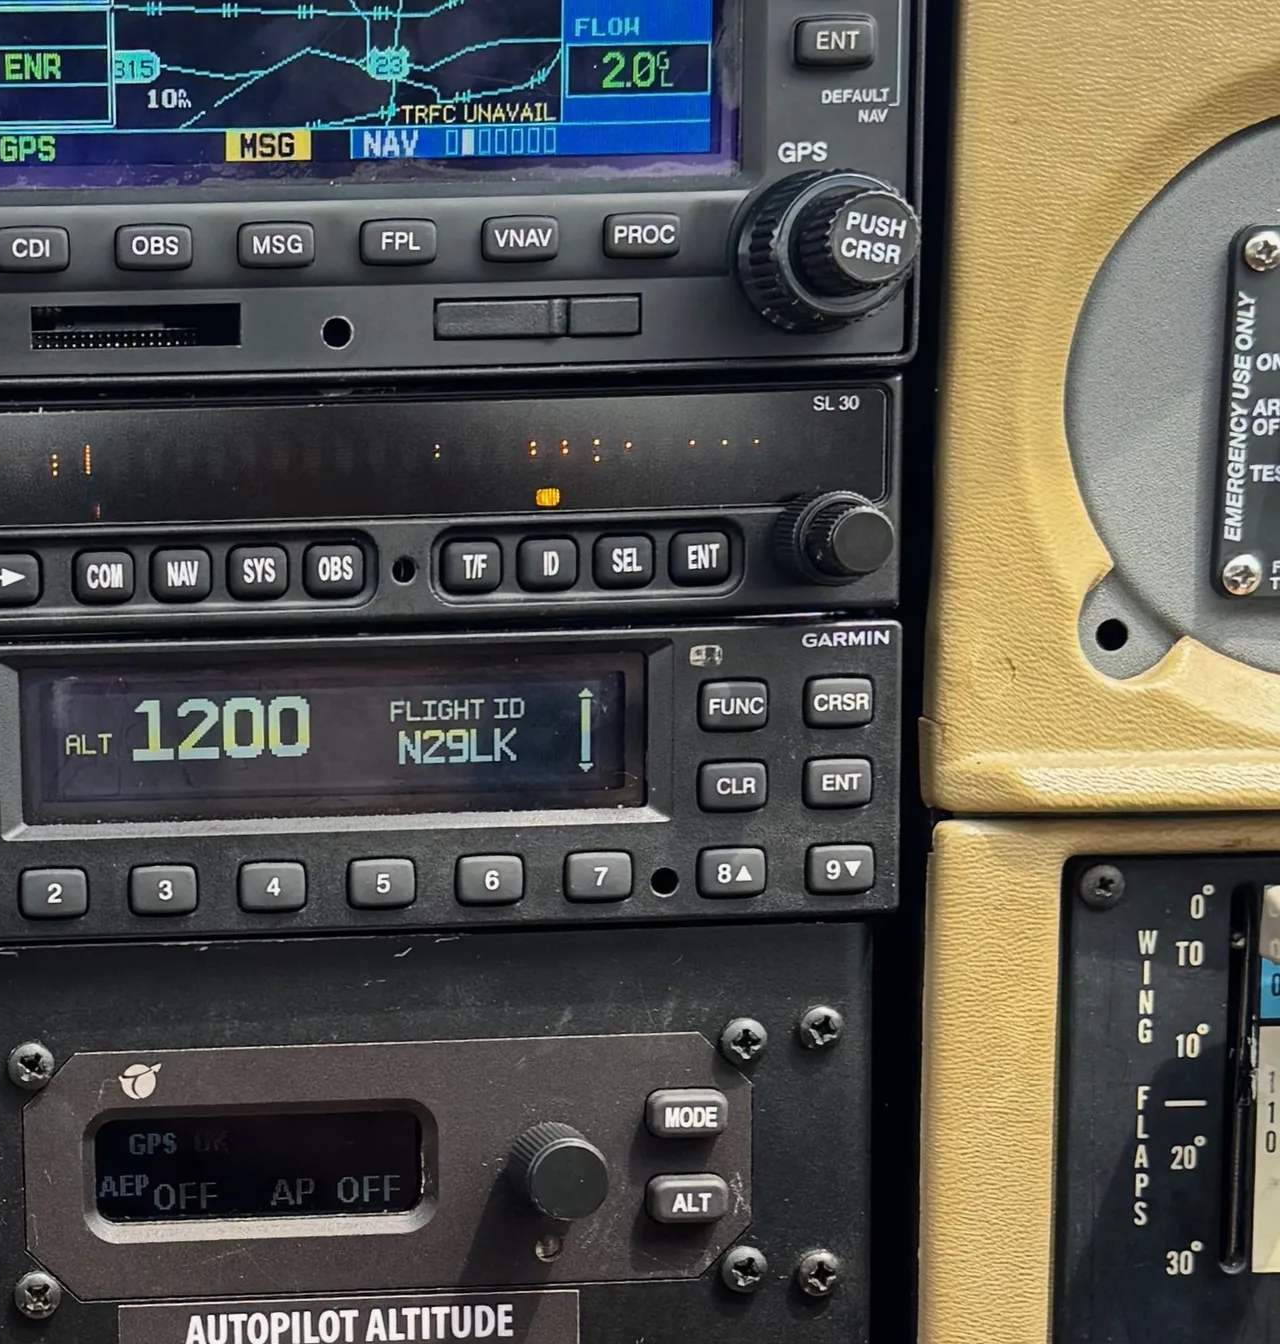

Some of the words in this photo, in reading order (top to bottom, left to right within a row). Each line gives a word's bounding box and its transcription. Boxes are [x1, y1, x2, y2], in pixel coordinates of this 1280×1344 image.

[574, 17, 639, 36] FLOW
[816, 32, 858, 50] ENT
[5, 54, 62, 80] ENR
[822, 88, 889, 104] DEFAULT
[401, 105, 457, 122] TRFC
[464, 103, 556, 122] UNAVAIL
[858, 108, 888, 123] NAV
[0, 136, 56, 162] GPS
[239, 133, 295, 158] MSG
[362, 131, 418, 156] NAV
[778, 142, 828, 162] GPS
[614, 224, 675, 244] PROC
[846, 212, 906, 238] PUSH
[132, 236, 178, 255] OBS
[253, 234, 302, 254] MSG
[381, 232, 420, 250] FPL
[494, 228, 552, 247] VNAV
[12, 239, 50, 257] CDI
[840, 238, 900, 264] CRSR
[1235, 292, 1256, 352] ONLY
[1232, 356, 1251, 400] USE
[813, 396, 835, 411] SL
[838, 395, 859, 411] 30
[1224, 402, 1248, 542] EMERGENCY
[612, 548, 642, 573] SEL
[688, 544, 720, 570] ENT
[243, 559, 276, 583] SYS
[802, 630, 889, 648] GARMIN
[390, 700, 483, 721] FLIGHT
[494, 698, 525, 719] ID
[708, 696, 764, 715] FUNC
[814, 693, 869, 712] CRSR
[133, 696, 310, 761] 1200
[399, 728, 516, 764] N29LK
[665, 1108, 717, 1128] MODE
[672, 1193, 711, 1213] ALT
[366, 1305, 513, 1342] ALTITUDE
